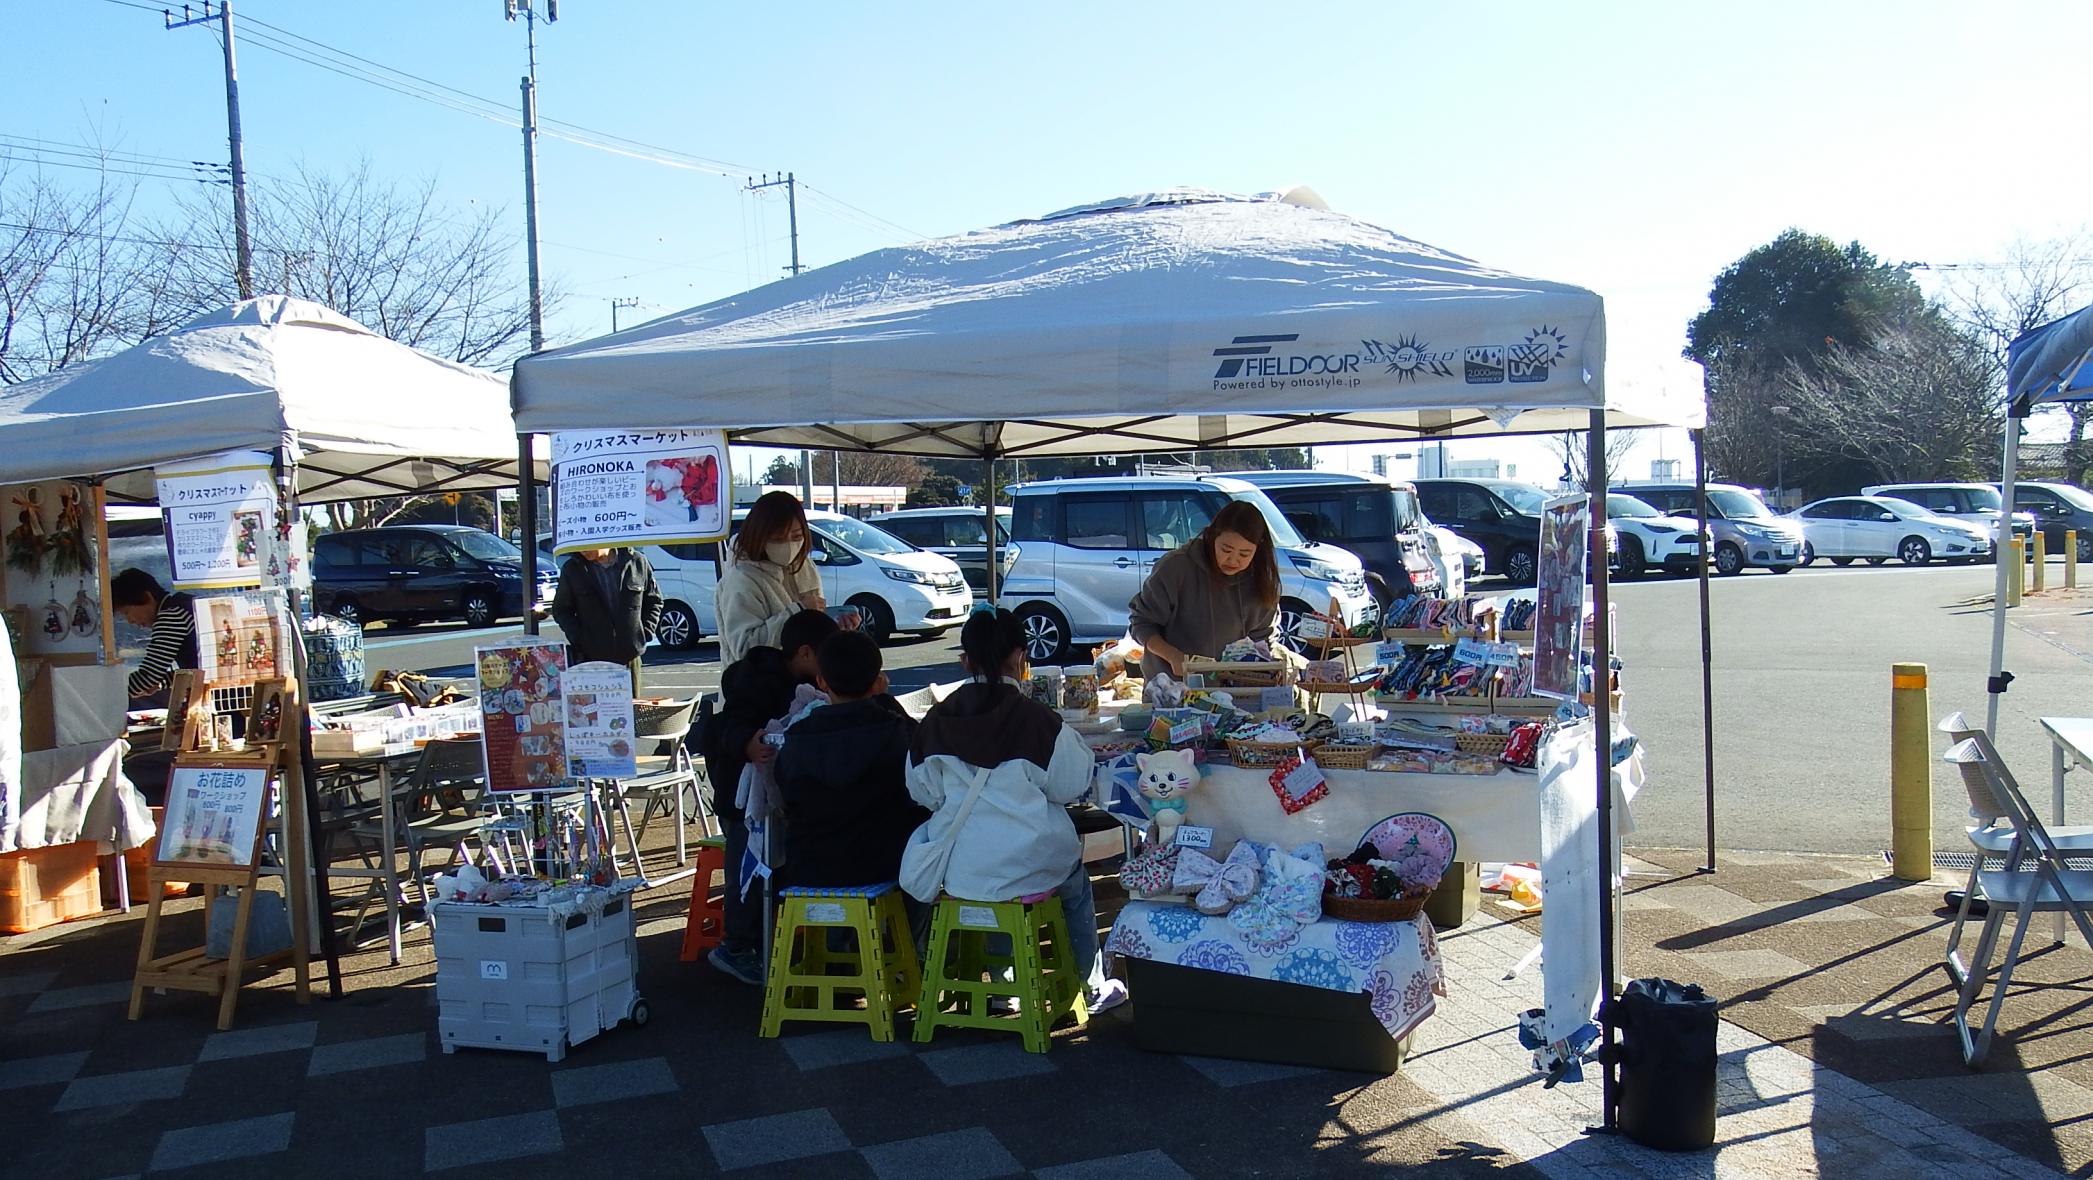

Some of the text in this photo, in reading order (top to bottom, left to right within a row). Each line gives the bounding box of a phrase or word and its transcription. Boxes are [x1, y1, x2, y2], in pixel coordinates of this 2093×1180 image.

[1246, 354, 1360, 377] FIELDOOR
[1213, 375, 1361, 393] Powered by ottostyle.jp
[573, 430, 688, 454] クリスマスマーケット
[567, 460, 635, 478] HIRONOKA
[188, 511, 217, 523] cyappy
[559, 516, 587, 527] ーズ小物
[197, 771, 246, 788] お花詰め
[199, 791, 247, 800] ワークショップ
